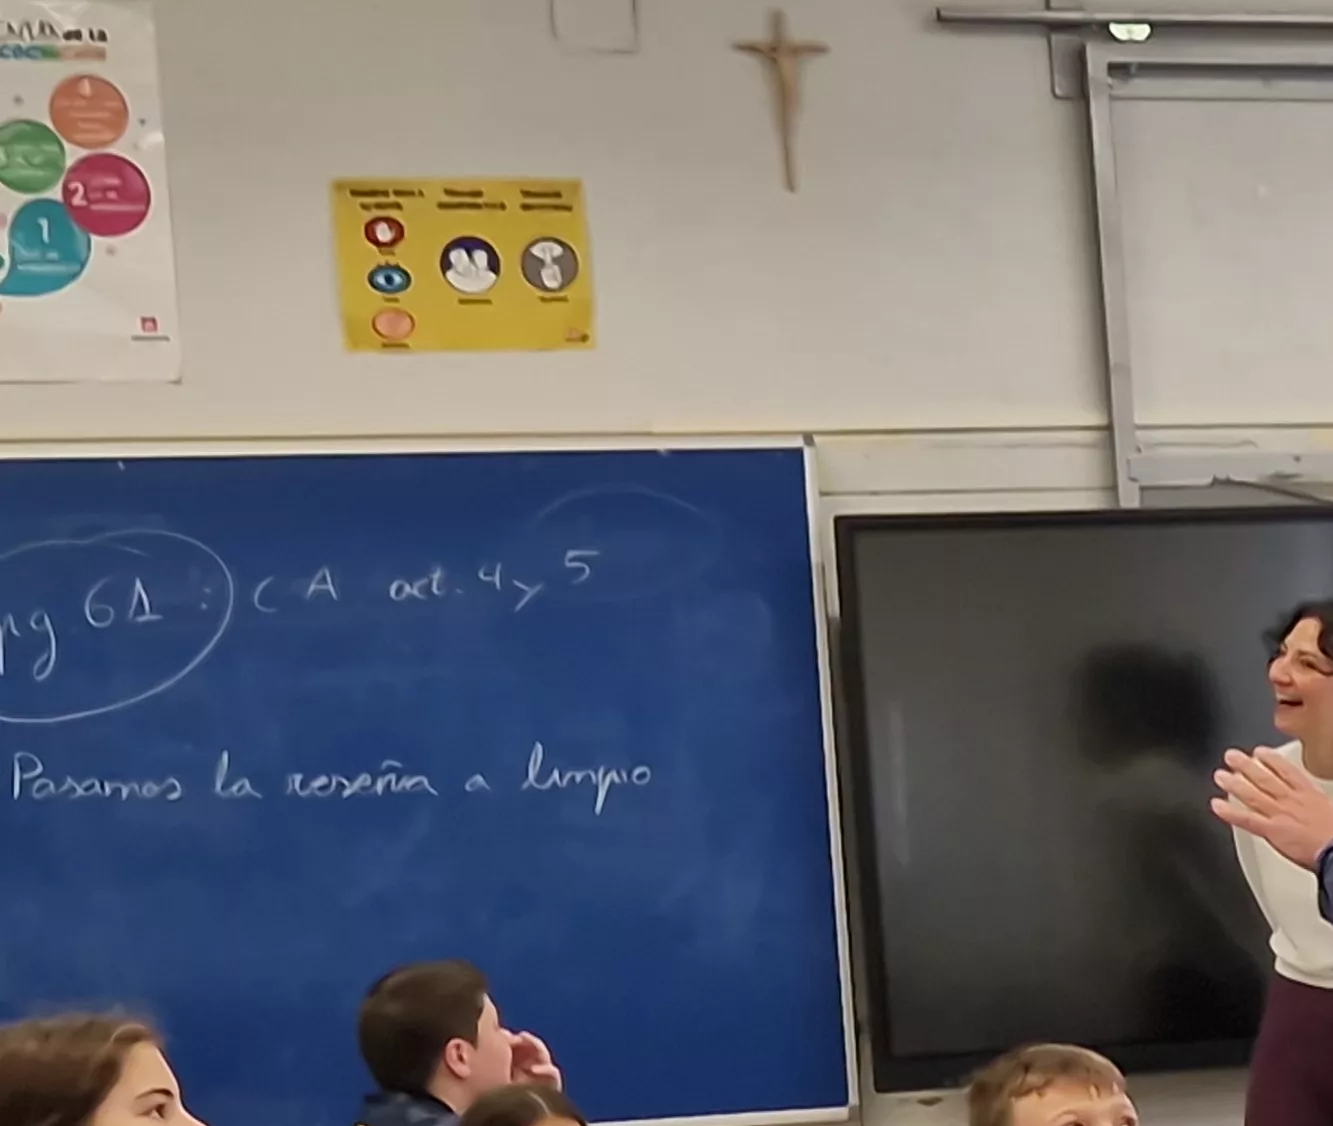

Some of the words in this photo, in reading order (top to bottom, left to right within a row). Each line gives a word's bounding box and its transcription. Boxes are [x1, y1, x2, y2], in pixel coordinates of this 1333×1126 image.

[67, 181, 89, 207] 2
[37, 216, 50, 244] 1
[564, 549, 600, 584] 5
[13, 750, 183, 801] Pasamos
[214, 749, 263, 799] la
[464, 773, 492, 793] a
